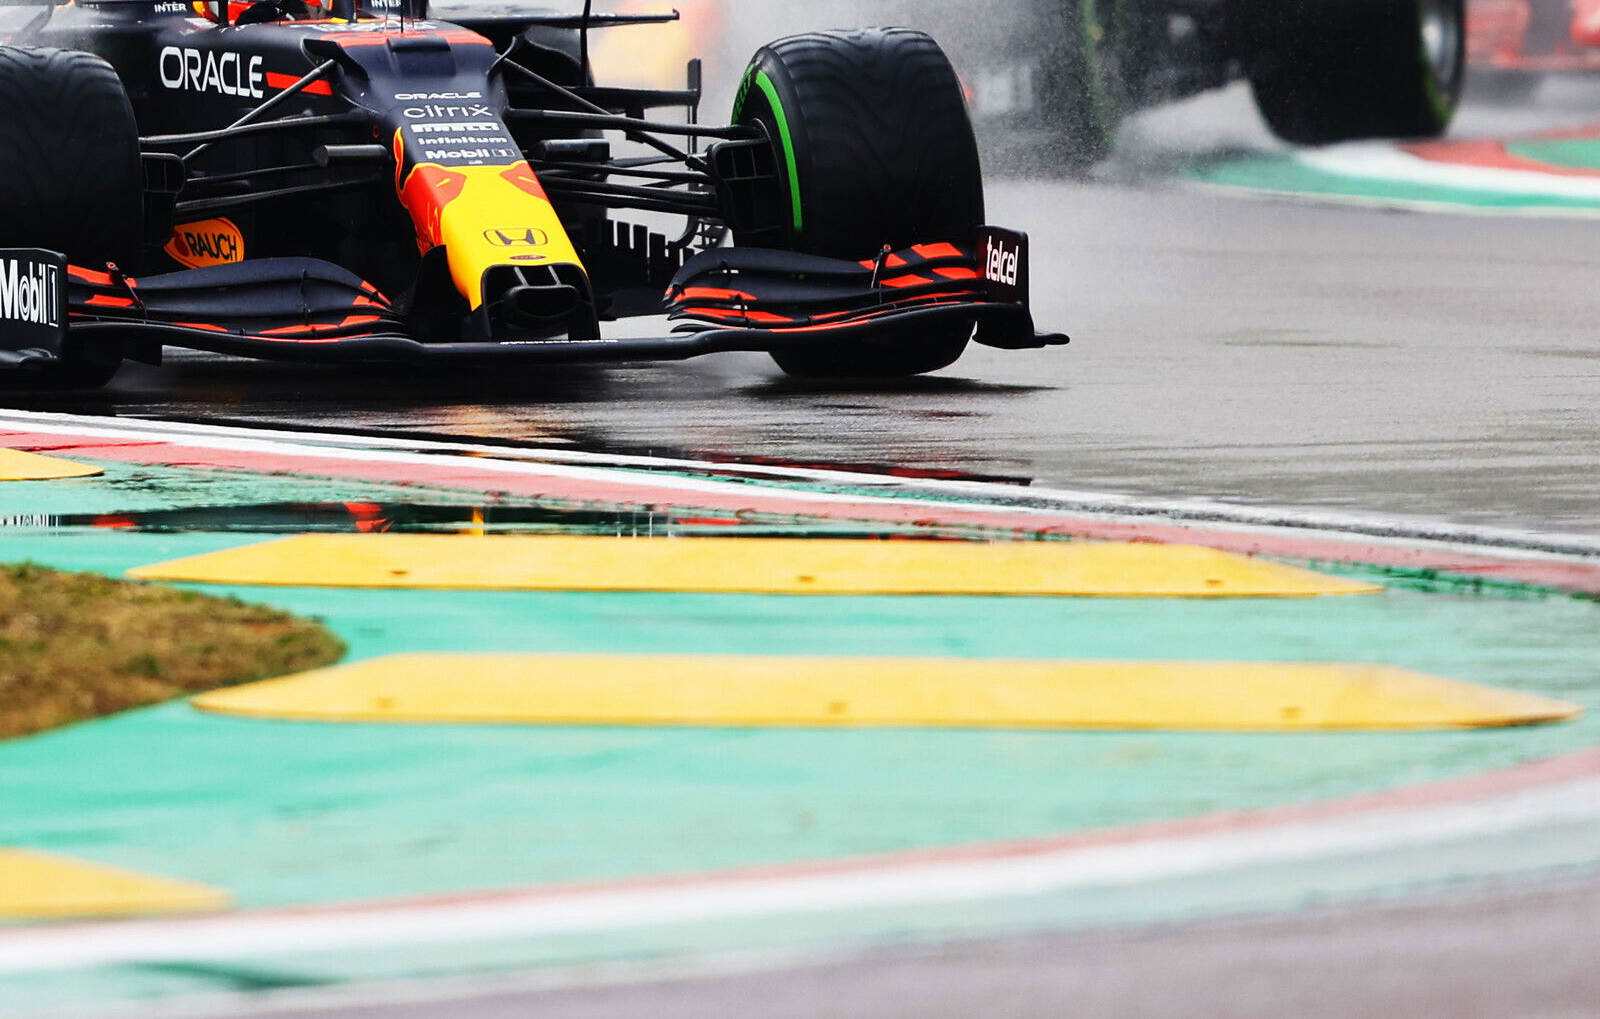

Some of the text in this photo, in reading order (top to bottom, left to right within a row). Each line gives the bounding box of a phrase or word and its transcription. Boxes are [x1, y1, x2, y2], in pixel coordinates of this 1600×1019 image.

[154, 1, 188, 13] INTER
[371, 0, 402, 9] INTER
[159, 46, 264, 99] ORACLE
[394, 92, 482, 100] ORACLE
[403, 104, 493, 119] citrix
[418, 136, 508, 145] infinitum
[425, 149, 490, 159] Mobil
[184, 231, 238, 261] RAUCH
[986, 235, 1019, 286] telcel
